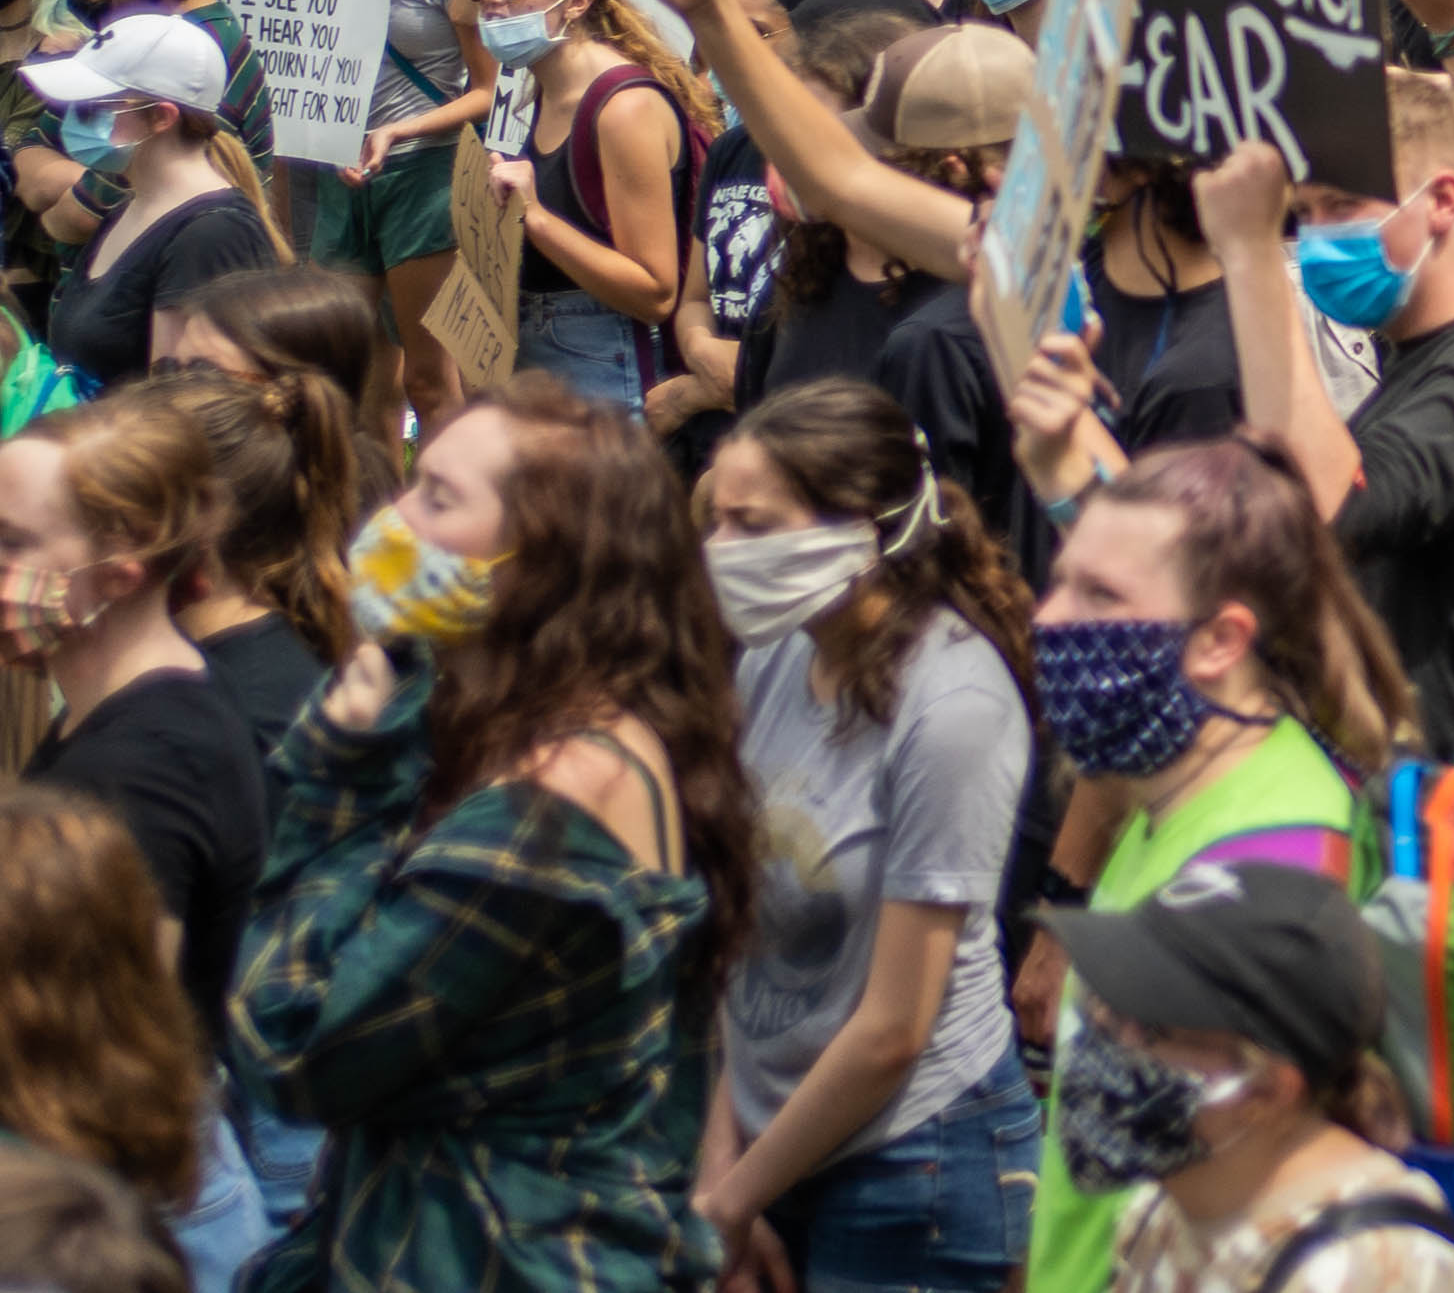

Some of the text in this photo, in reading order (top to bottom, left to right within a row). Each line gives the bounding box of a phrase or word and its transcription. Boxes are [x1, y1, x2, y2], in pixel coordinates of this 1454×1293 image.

[258, 15, 302, 48] HEAR
[310, 21, 341, 51] YOU
[335, 58, 364, 86] YOU
[268, 85, 300, 118] GHT
[300, 90, 327, 123] FOR
